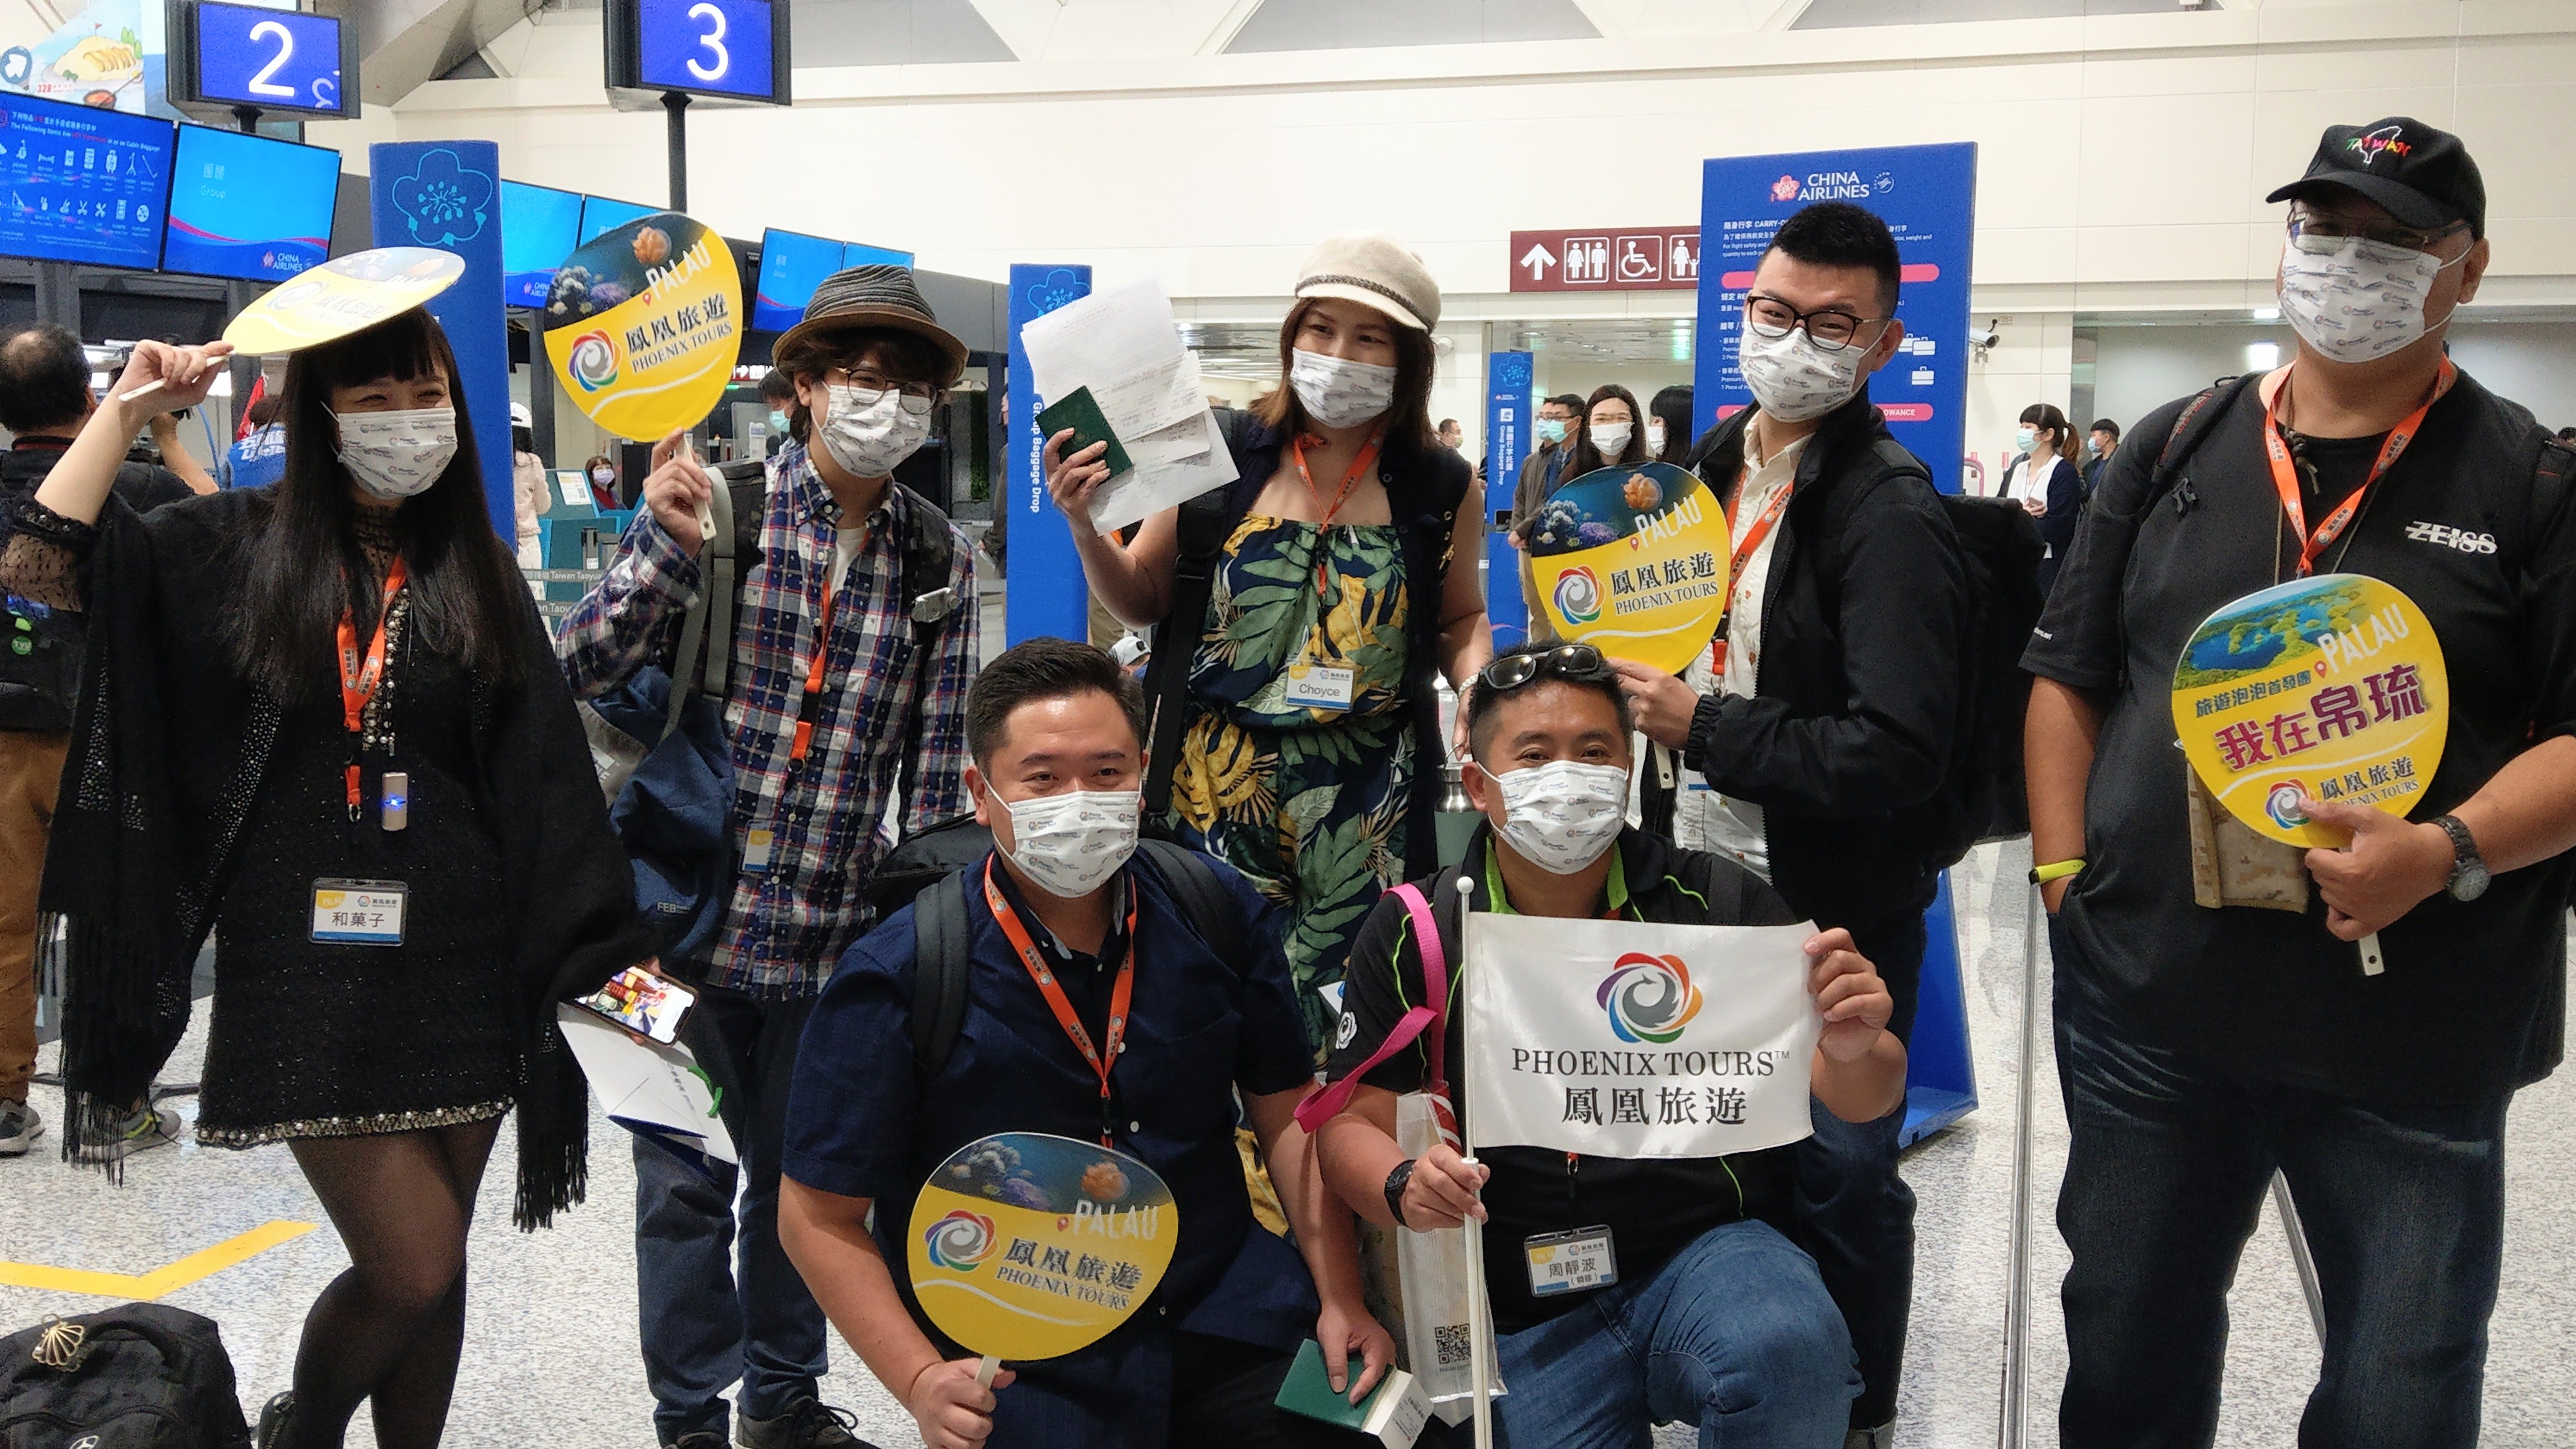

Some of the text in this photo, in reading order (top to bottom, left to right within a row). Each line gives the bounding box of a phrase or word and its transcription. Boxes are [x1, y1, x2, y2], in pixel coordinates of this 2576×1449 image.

[249, 21, 294, 96] 2
[687, 3, 728, 80] 3
[2345, 136, 2412, 158] TAIWAN
[201, 185, 226, 200] Group
[1797, 184, 1870, 202] AIRLINES
[1807, 171, 1861, 187] CHINA
[272, 261, 303, 272] AIRLINES
[277, 252, 299, 263] CHINA
[645, 240, 712, 301] PALAU
[625, 294, 728, 355] 鳳凰旅遊
[631, 321, 733, 374] PHOENIX TOURS
[1883, 408, 1915, 417] OWANCE
[1030, 437, 1043, 484] Baggage
[1030, 487, 1042, 513] Drop
[1634, 493, 1703, 548] PALAU
[2405, 520, 2498, 554] ZEISS
[550, 571, 576, 579] Taiwan
[577, 571, 603, 580] Taoyua
[1611, 551, 1716, 598] 鳳凰旅遊
[549, 603, 571, 613] Taoy
[1615, 581, 1719, 616] PHOENIX TOURS
[2317, 603, 2409, 674] PALAU
[1299, 683, 1341, 698] Choyce
[2195, 668, 2312, 719] 旅遊泡泡首發團
[2213, 663, 2427, 772] 我在帛琉
[2320, 756, 2416, 802] 鳳凰旅遊
[2382, 779, 2420, 800] TOURS
[332, 911, 384, 927] 和菓子
[1511, 1048, 1657, 1077] PHOENIX
[1562, 1086, 1747, 1126] 鳳凰旅遊
[1072, 1198, 1159, 1241] PALAU
[1003, 1237, 1144, 1292] 鳳凰旅遊
[995, 1265, 1131, 1311] PHOENIX TOURS
